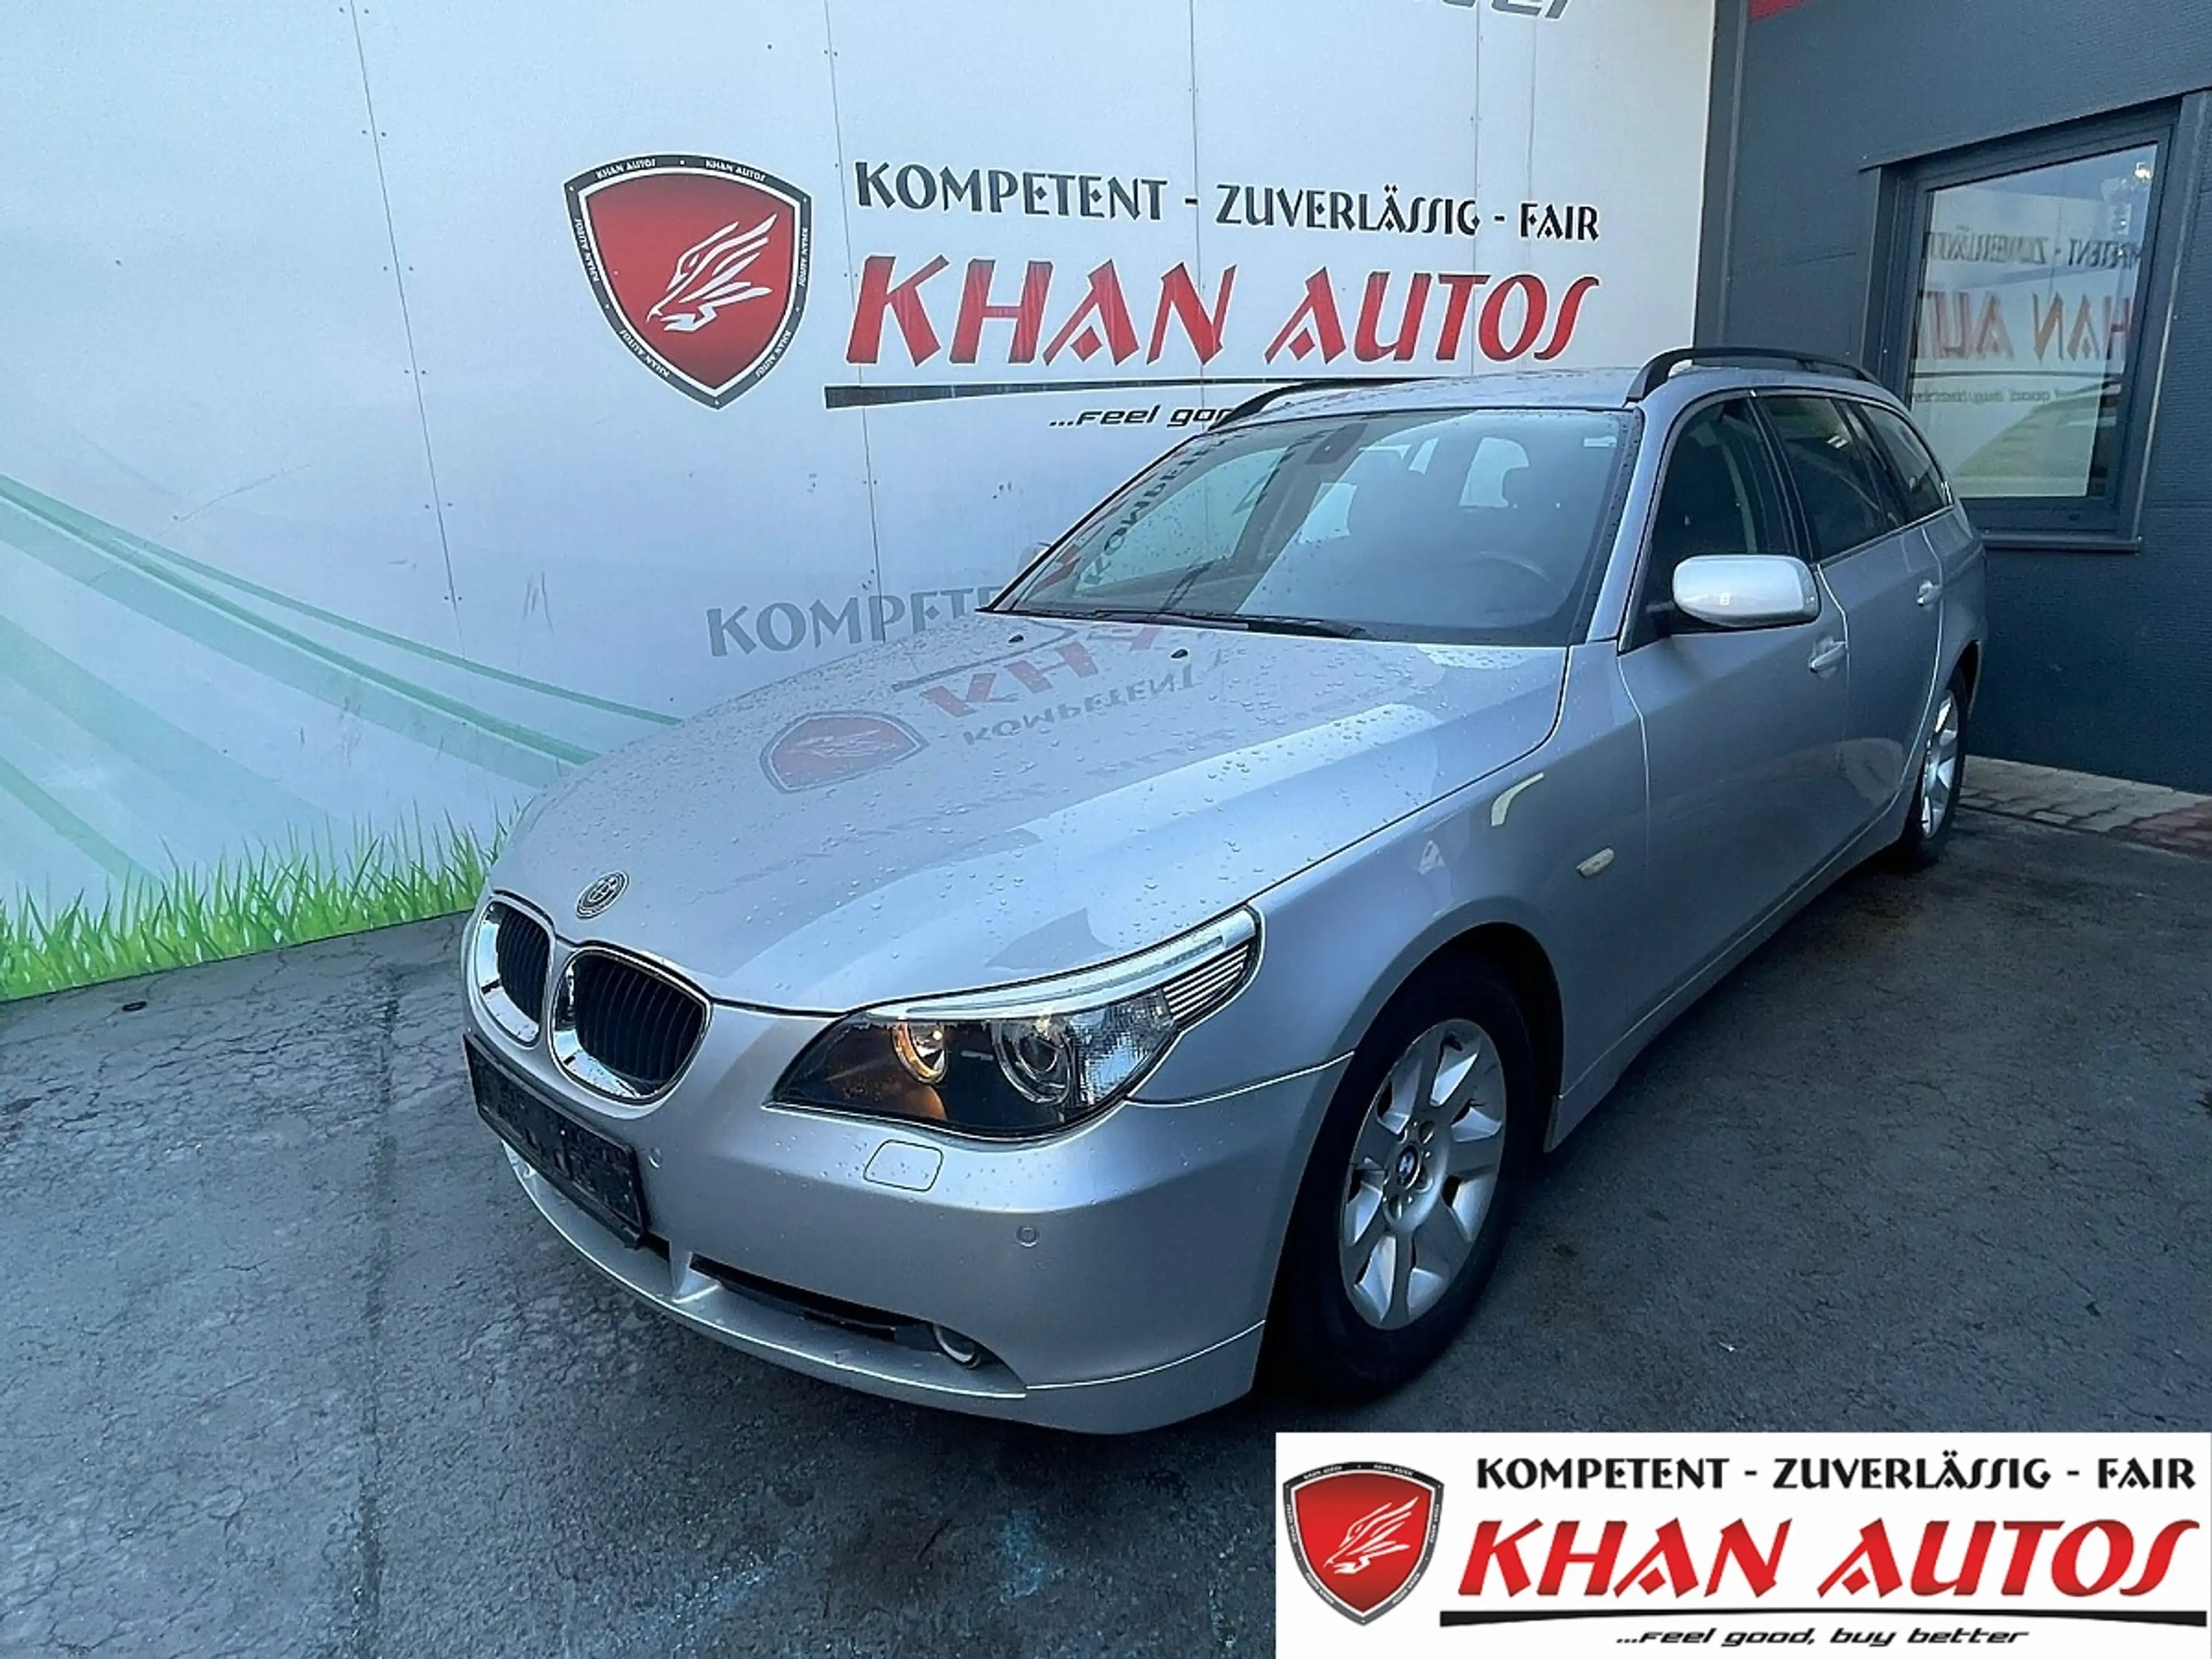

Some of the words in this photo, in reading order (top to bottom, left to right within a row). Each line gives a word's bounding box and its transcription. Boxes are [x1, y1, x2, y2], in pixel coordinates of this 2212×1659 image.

[735, 166, 766, 181] AUTOS
[855, 161, 1168, 220] KOMPETENT
[1215, 183, 1480, 235] ZUVERLÄSSIG
[1520, 202, 1599, 241] FAIR
[846, 254, 1237, 366] KHAN
[1264, 266, 1600, 365] AUTOS
